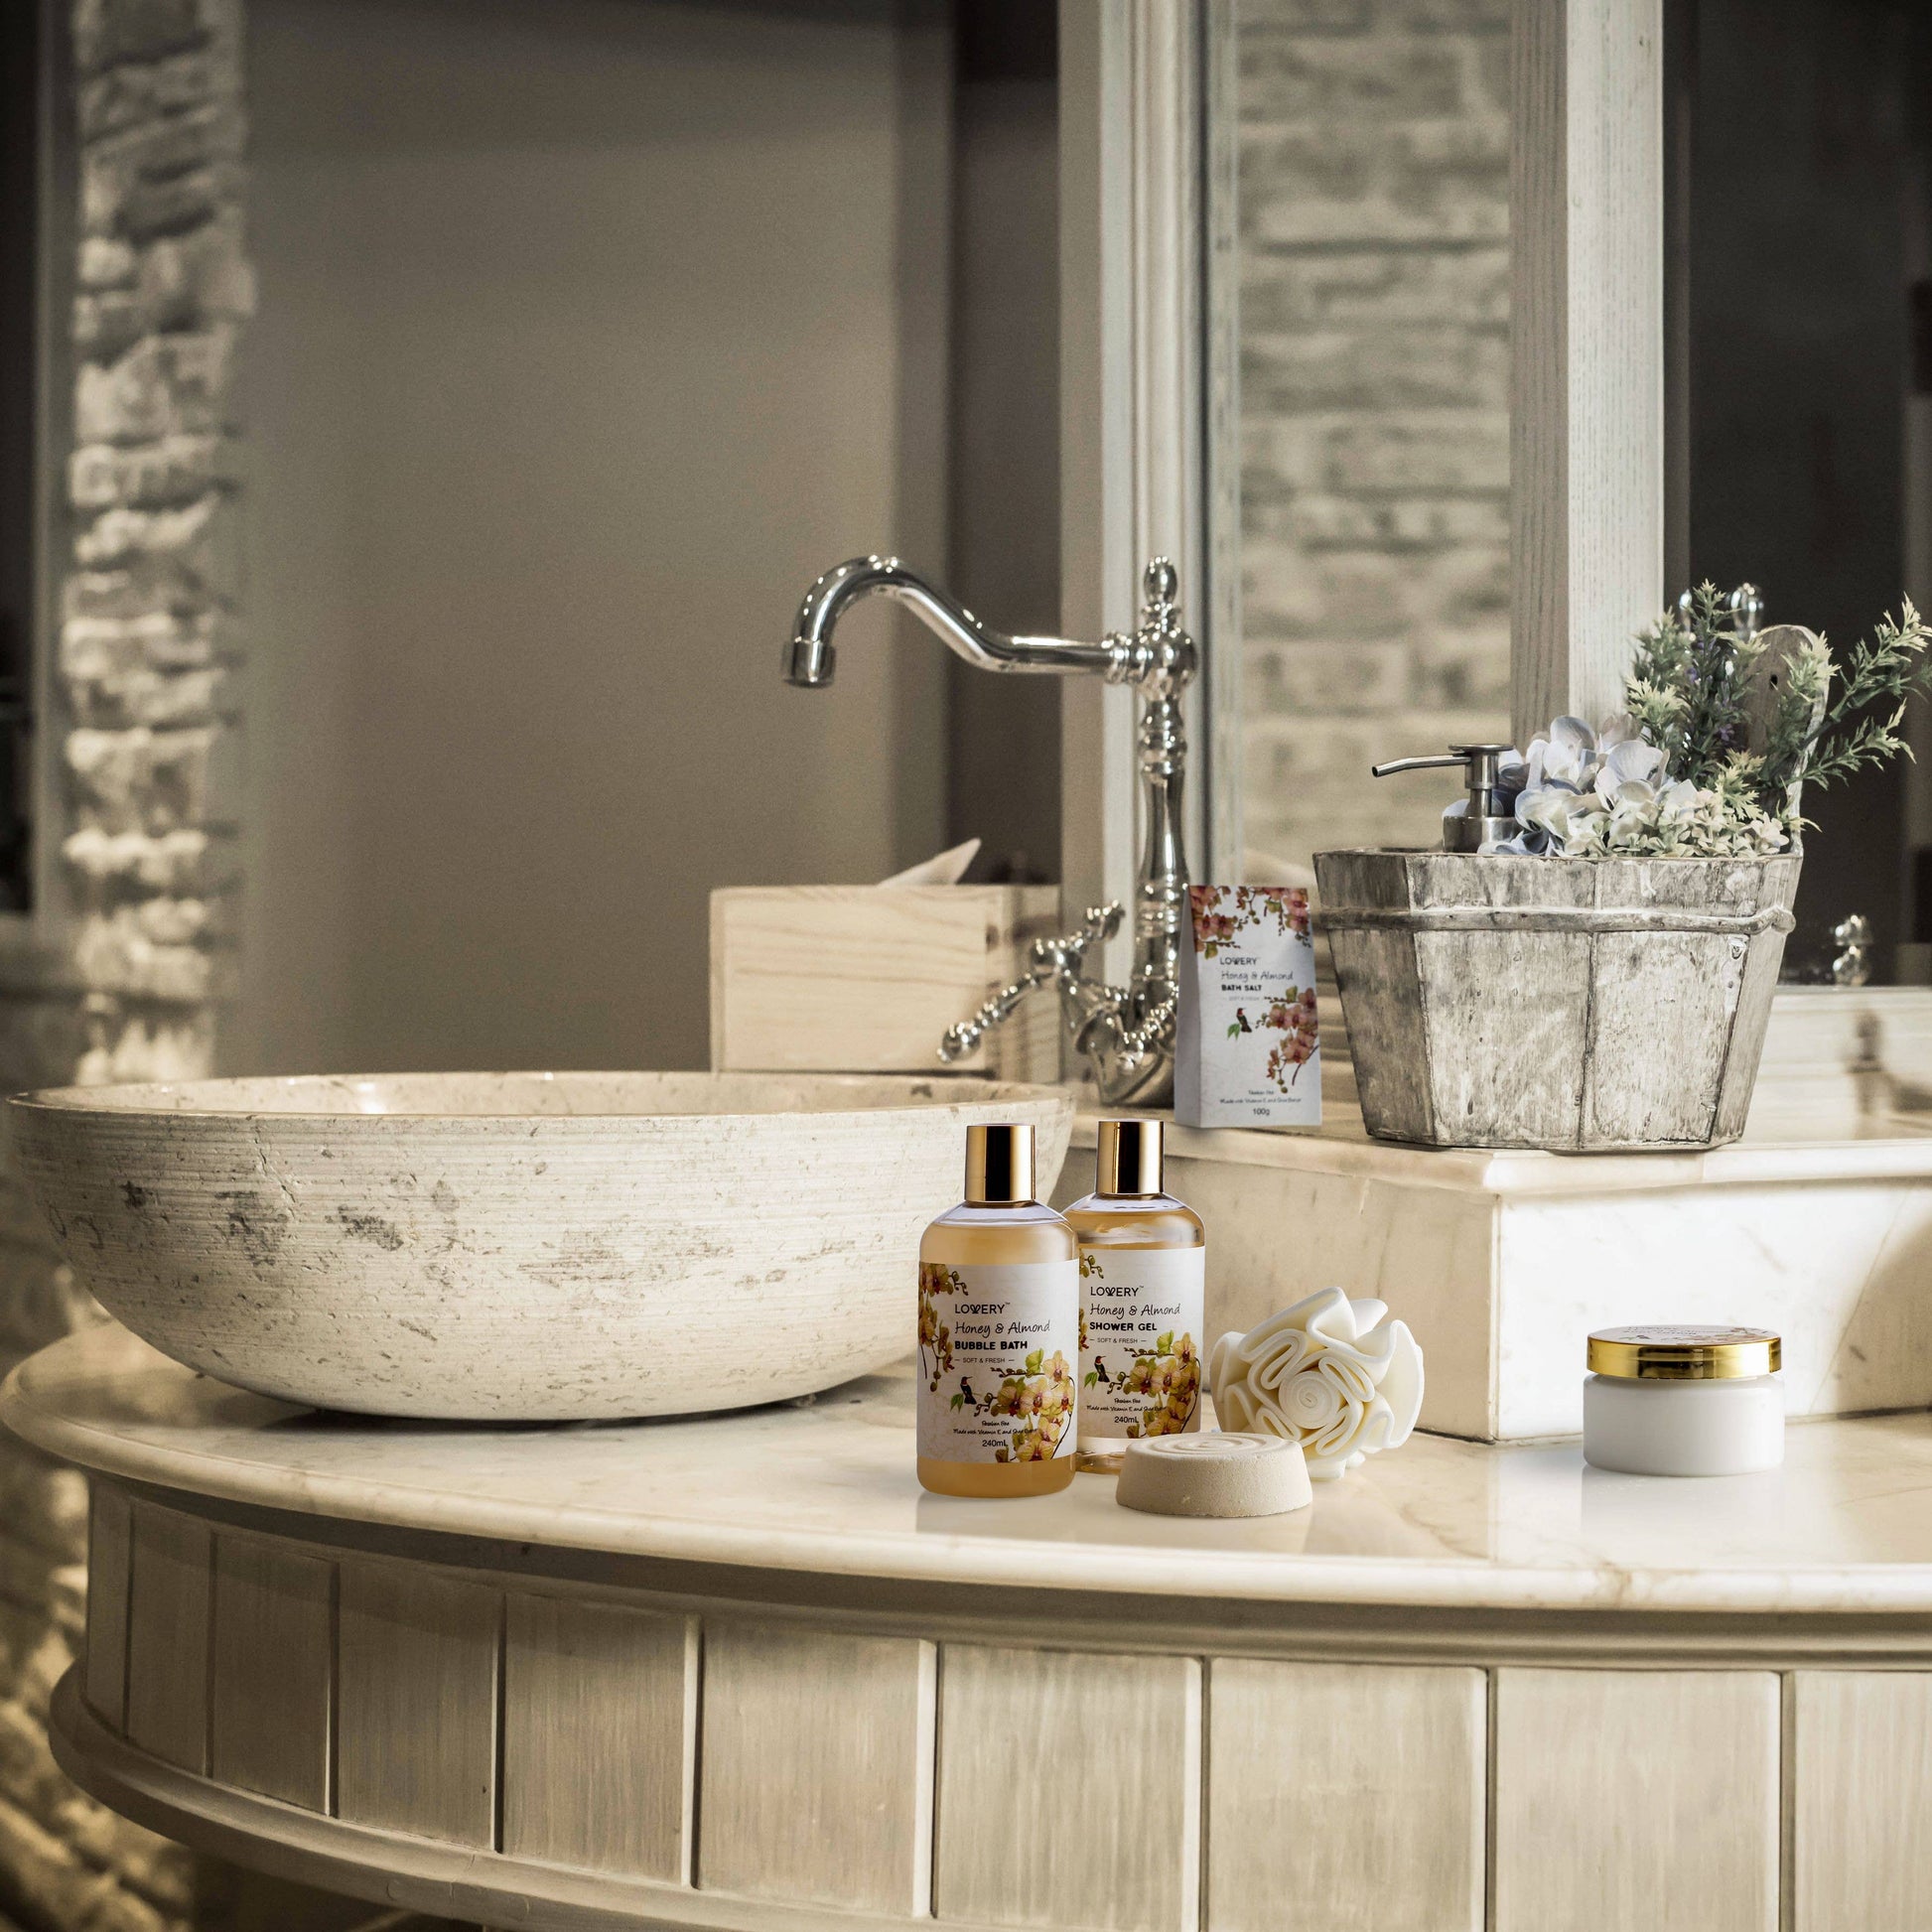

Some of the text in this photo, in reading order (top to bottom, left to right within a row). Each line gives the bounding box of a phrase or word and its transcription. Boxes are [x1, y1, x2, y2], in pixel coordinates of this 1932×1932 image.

[1221, 970, 1294, 983] Honey & Almond
[1090, 1303, 1180, 1319] Honey & Almond
[954, 1319, 1050, 1338] Honey & Almond
[1089, 1321, 1134, 1330] SHOWER
[955, 1340, 1028, 1350] BUBBLE BATH
